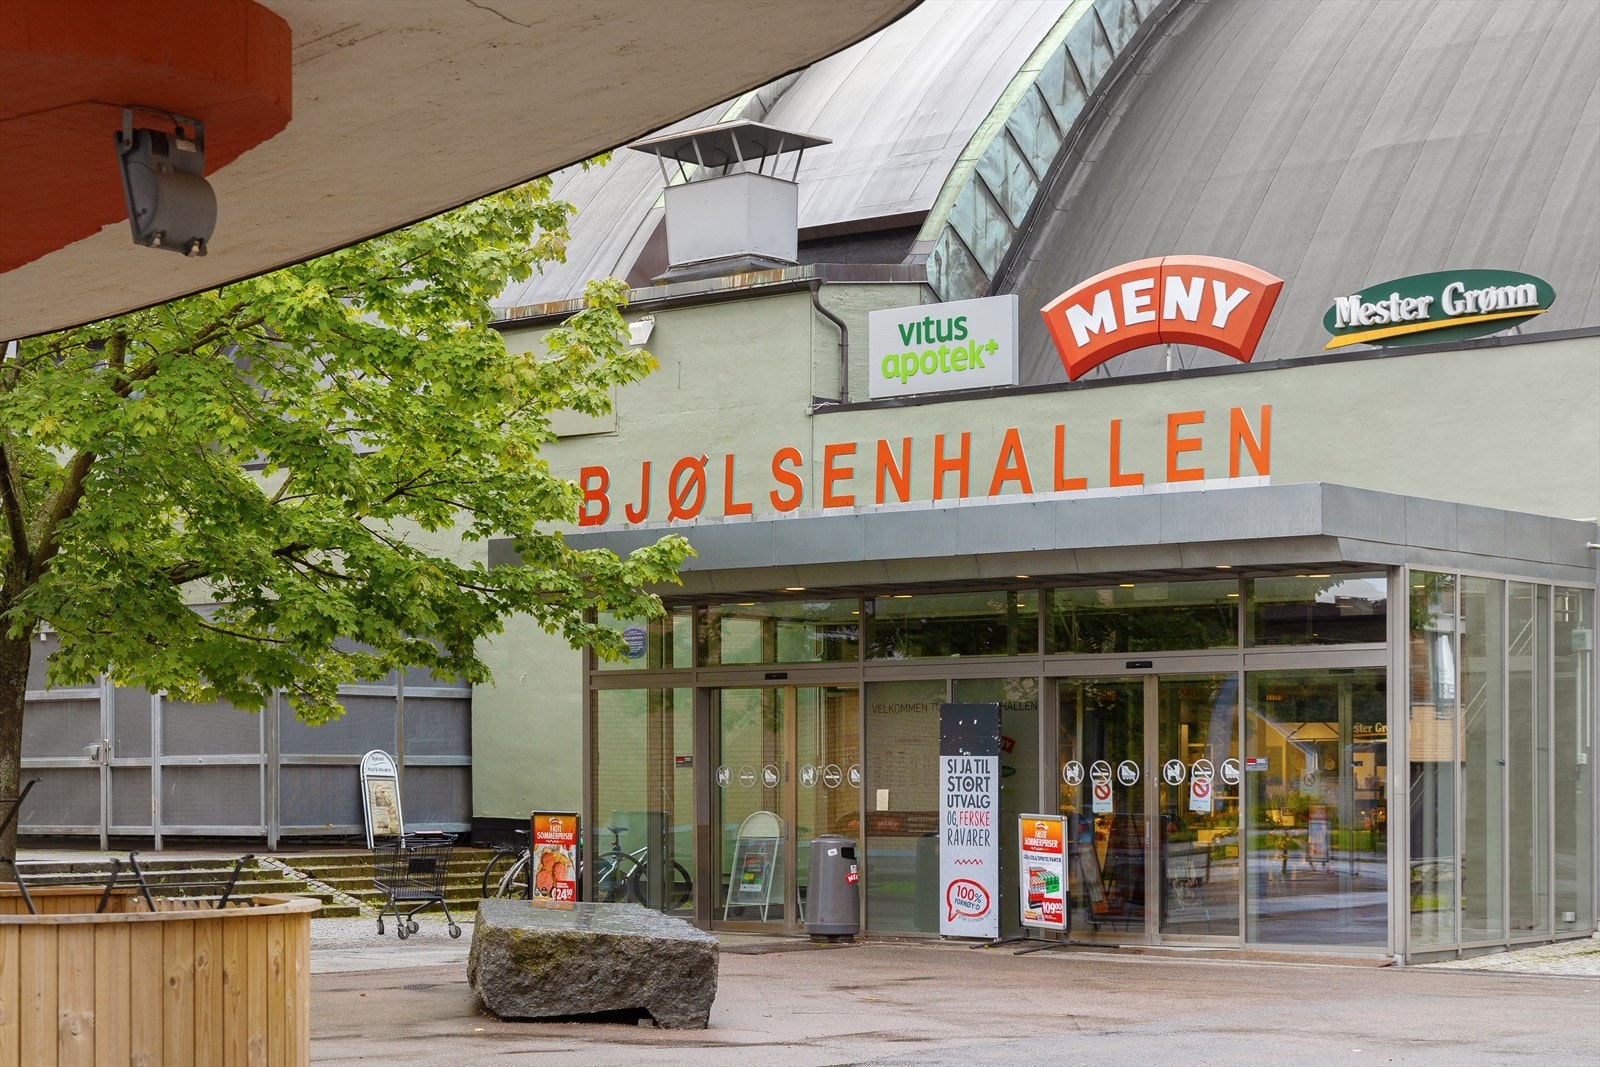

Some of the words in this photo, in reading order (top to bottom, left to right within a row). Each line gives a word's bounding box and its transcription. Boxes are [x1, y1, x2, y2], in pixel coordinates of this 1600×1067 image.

[1067, 278, 1250, 347] MENY
[1333, 290, 1434, 328] Mester
[1440, 281, 1539, 316] Grønn
[898, 316, 967, 344] vitus
[579, 405, 1272, 526] BJØLSENHALLEN
[872, 703, 928, 713] VELKOMMEN
[999, 700, 1038, 711] HALLEN
[948, 759, 957, 774] SI
[960, 759, 972, 774] JA
[974, 759, 990, 774] TIL
[948, 776, 990, 792] STORT
[948, 794, 990, 809] UTVALG
[948, 811, 957, 826] OG
[960, 811, 990, 826] FERSKE
[957, 885, 983, 903] 100%
